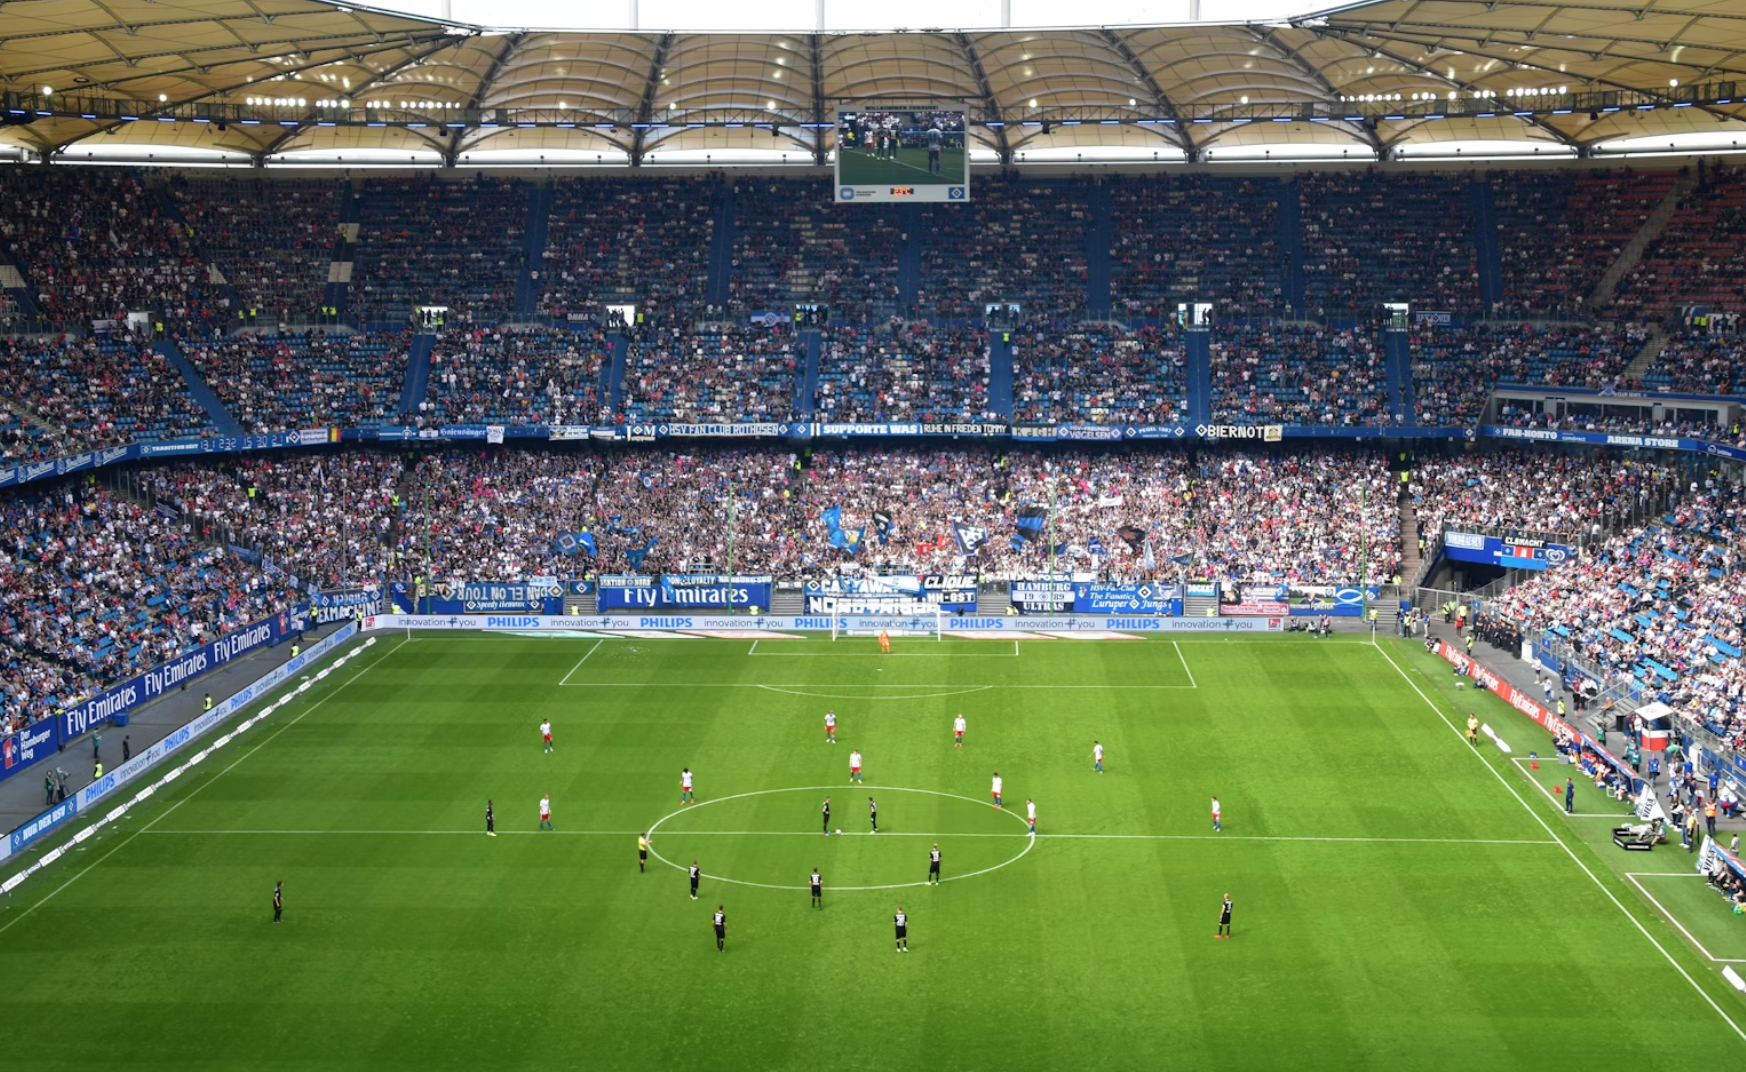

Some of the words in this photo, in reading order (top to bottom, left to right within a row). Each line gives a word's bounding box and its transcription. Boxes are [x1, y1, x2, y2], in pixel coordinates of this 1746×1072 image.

[669, 424, 686, 434] HSV
[690, 424, 705, 434] FAN
[709, 424, 731, 434] CLUB
[733, 424, 778, 434] ROTHOSEN
[823, 424, 888, 434] SUPPORTE
[890, 424, 918, 434] WAS
[952, 424, 981, 433] FRIEDEN
[1207, 424, 1264, 438] BIERNOT
[1503, 428, 1557, 440] FAN-KONTO
[1607, 435, 1643, 445] ARENA
[1644, 437, 1679, 448] STORE
[924, 576, 977, 589] CLIQUE
[1016, 582, 1071, 591] HAMBURG
[1023, 602, 1064, 611] ULTRAS
[487, 617, 540, 627] PHILIPS
[640, 618, 693, 627] PHILIPS
[794, 618, 847, 628] PHILIPS
[950, 618, 1003, 628] PHILIPS
[1106, 619, 1160, 629] PHILIPS
[214, 640, 231, 662] Fly
[231, 623, 271, 654] Emirates
[144, 672, 162, 695] Fly
[164, 652, 207, 686] Emirates
[67, 709, 87, 735] Fly
[88, 686, 137, 724] Emirates
[21, 730, 31, 741] Der
[21, 729, 51, 751] Hamburger
[86, 773, 115, 803] PHILIPS
[164, 726, 190, 752] PHILIPS
[230, 687, 253, 710] PHILIPS
[22, 748, 34, 760] Weg
[1642, 798, 1655, 819] VISA
[23, 823, 38, 841] NUR
[38, 814, 52, 831] DER
[52, 805, 66, 822] HSV
